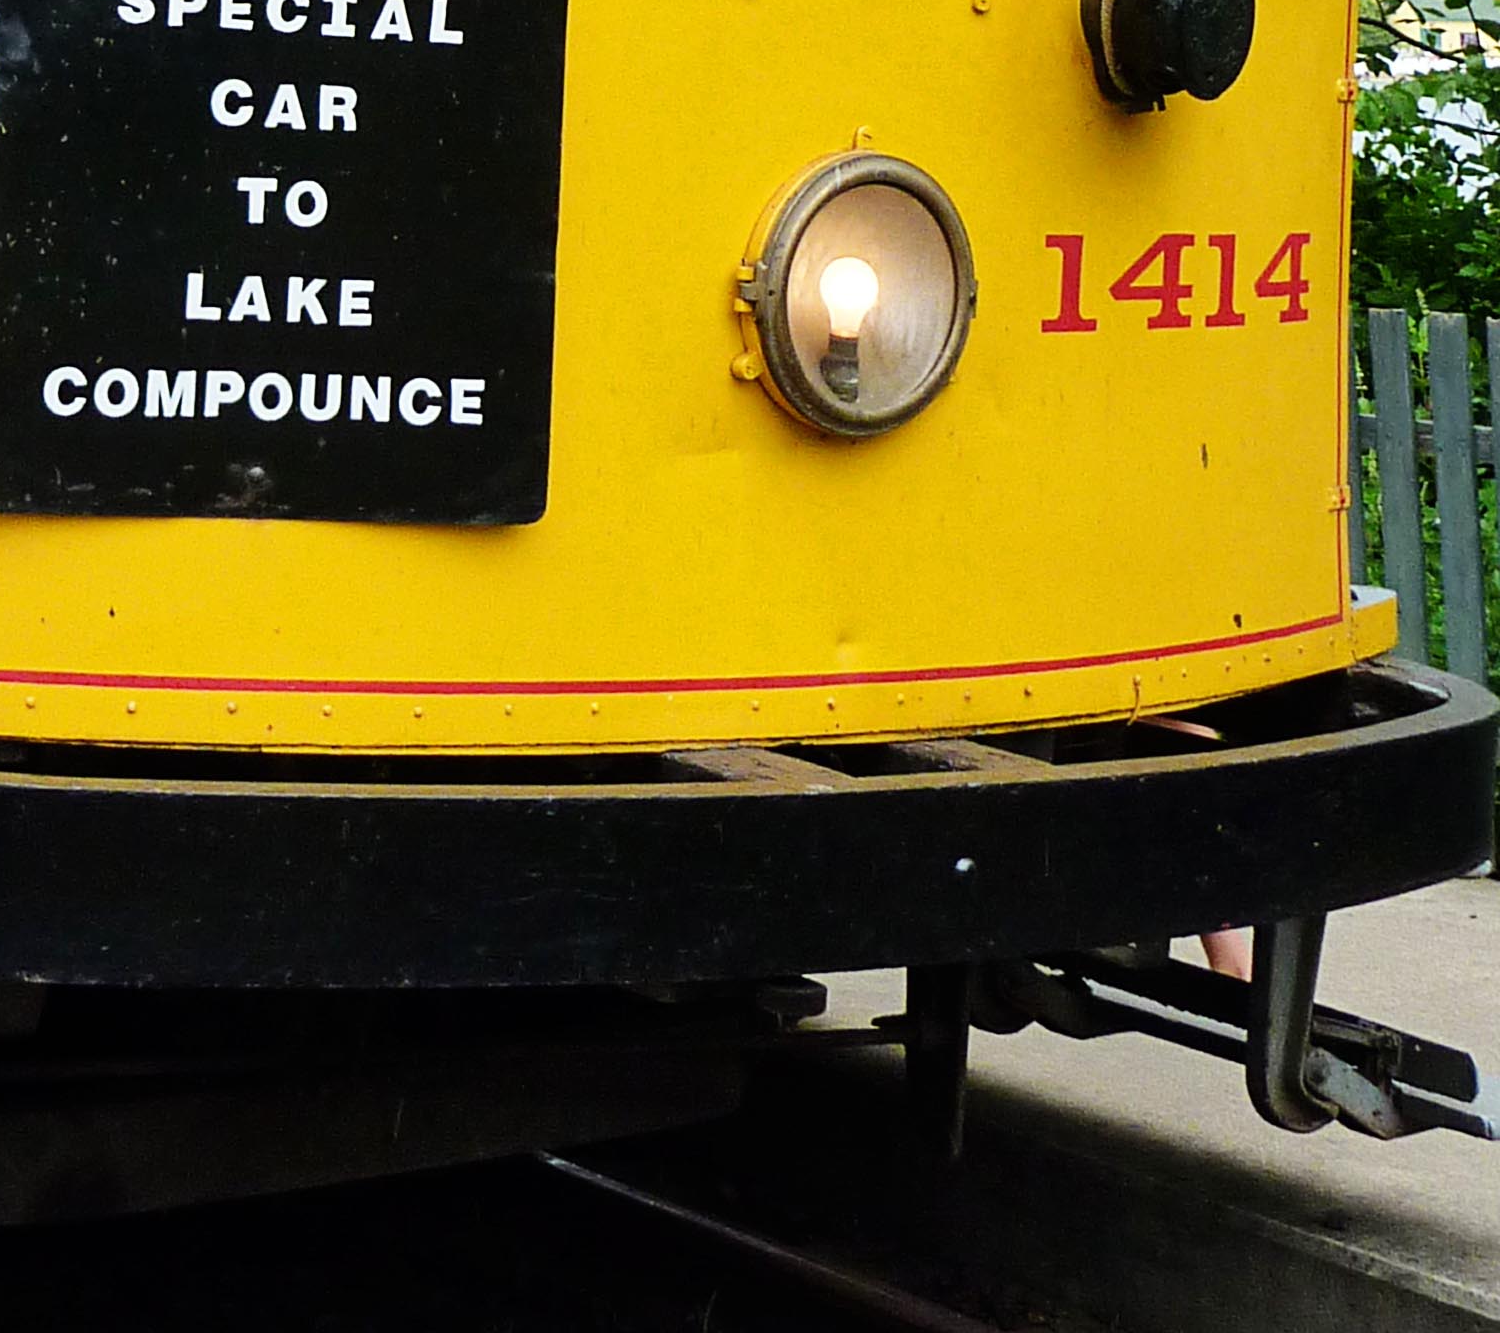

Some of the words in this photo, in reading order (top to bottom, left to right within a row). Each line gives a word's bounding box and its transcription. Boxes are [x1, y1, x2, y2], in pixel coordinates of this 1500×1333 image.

[209, 78, 359, 132] CAR
[236, 176, 329, 228] TO
[184, 272, 376, 328] LAKE
[1040, 231, 1312, 334] 1414
[42, 365, 487, 428] COMPOUNCE
